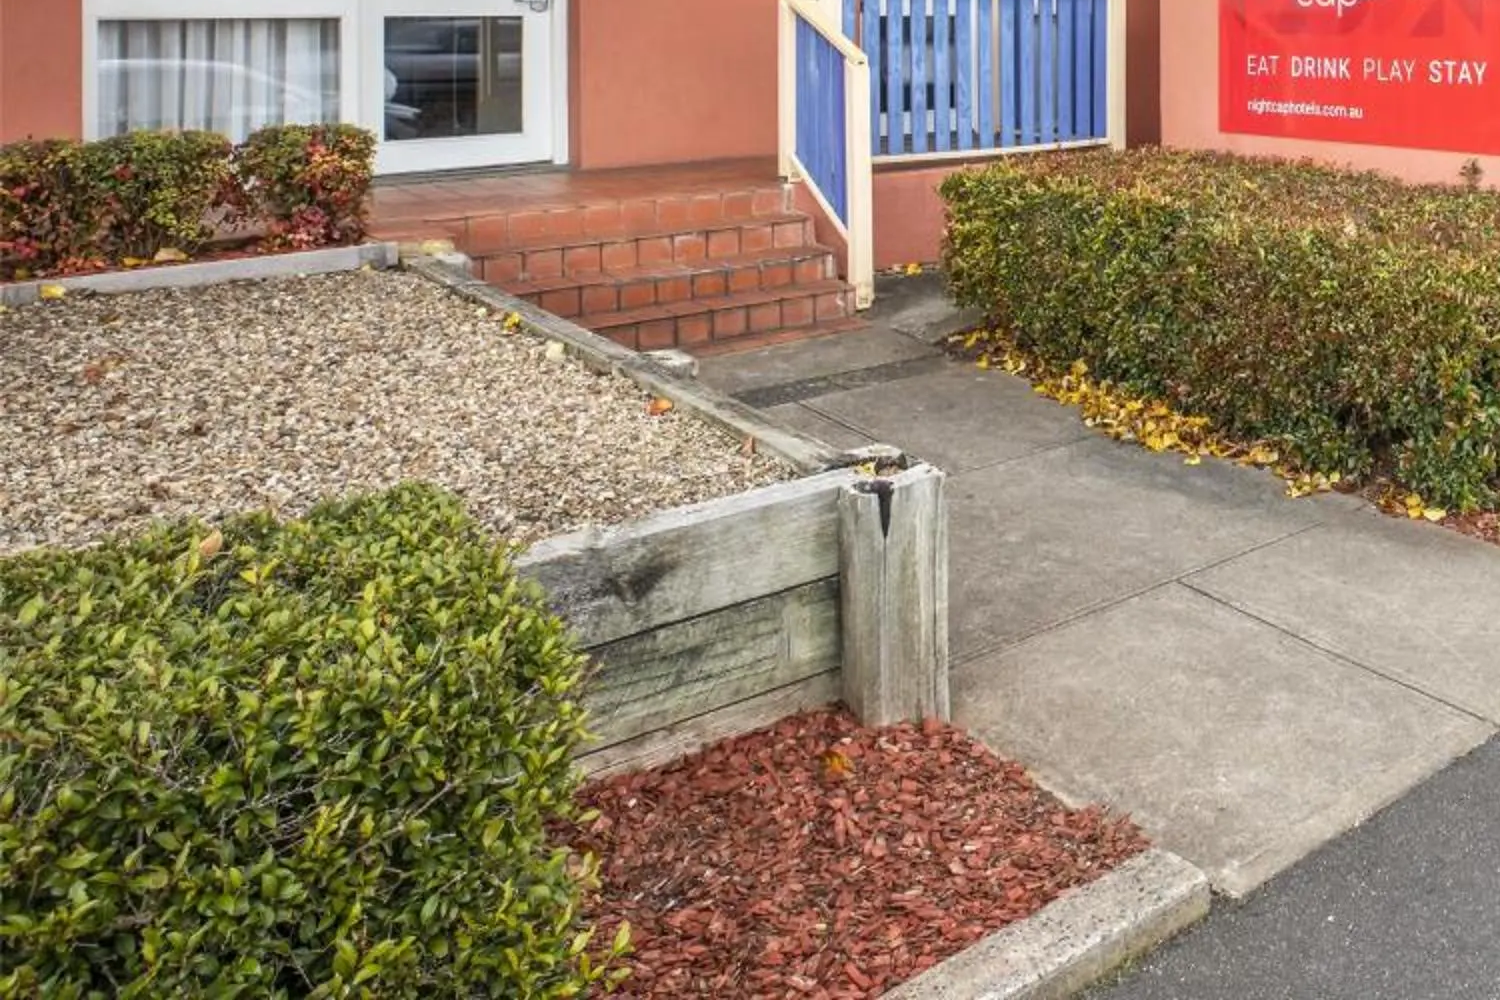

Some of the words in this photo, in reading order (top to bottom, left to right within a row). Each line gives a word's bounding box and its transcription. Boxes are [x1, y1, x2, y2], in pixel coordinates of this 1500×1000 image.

[1247, 55, 1280, 77] EAT
[1291, 58, 1351, 80] DRINK
[1363, 59, 1416, 83] PLAY
[1428, 61, 1488, 85] STAY
[1247, 98, 1364, 119] nightcaphotels.com.au
